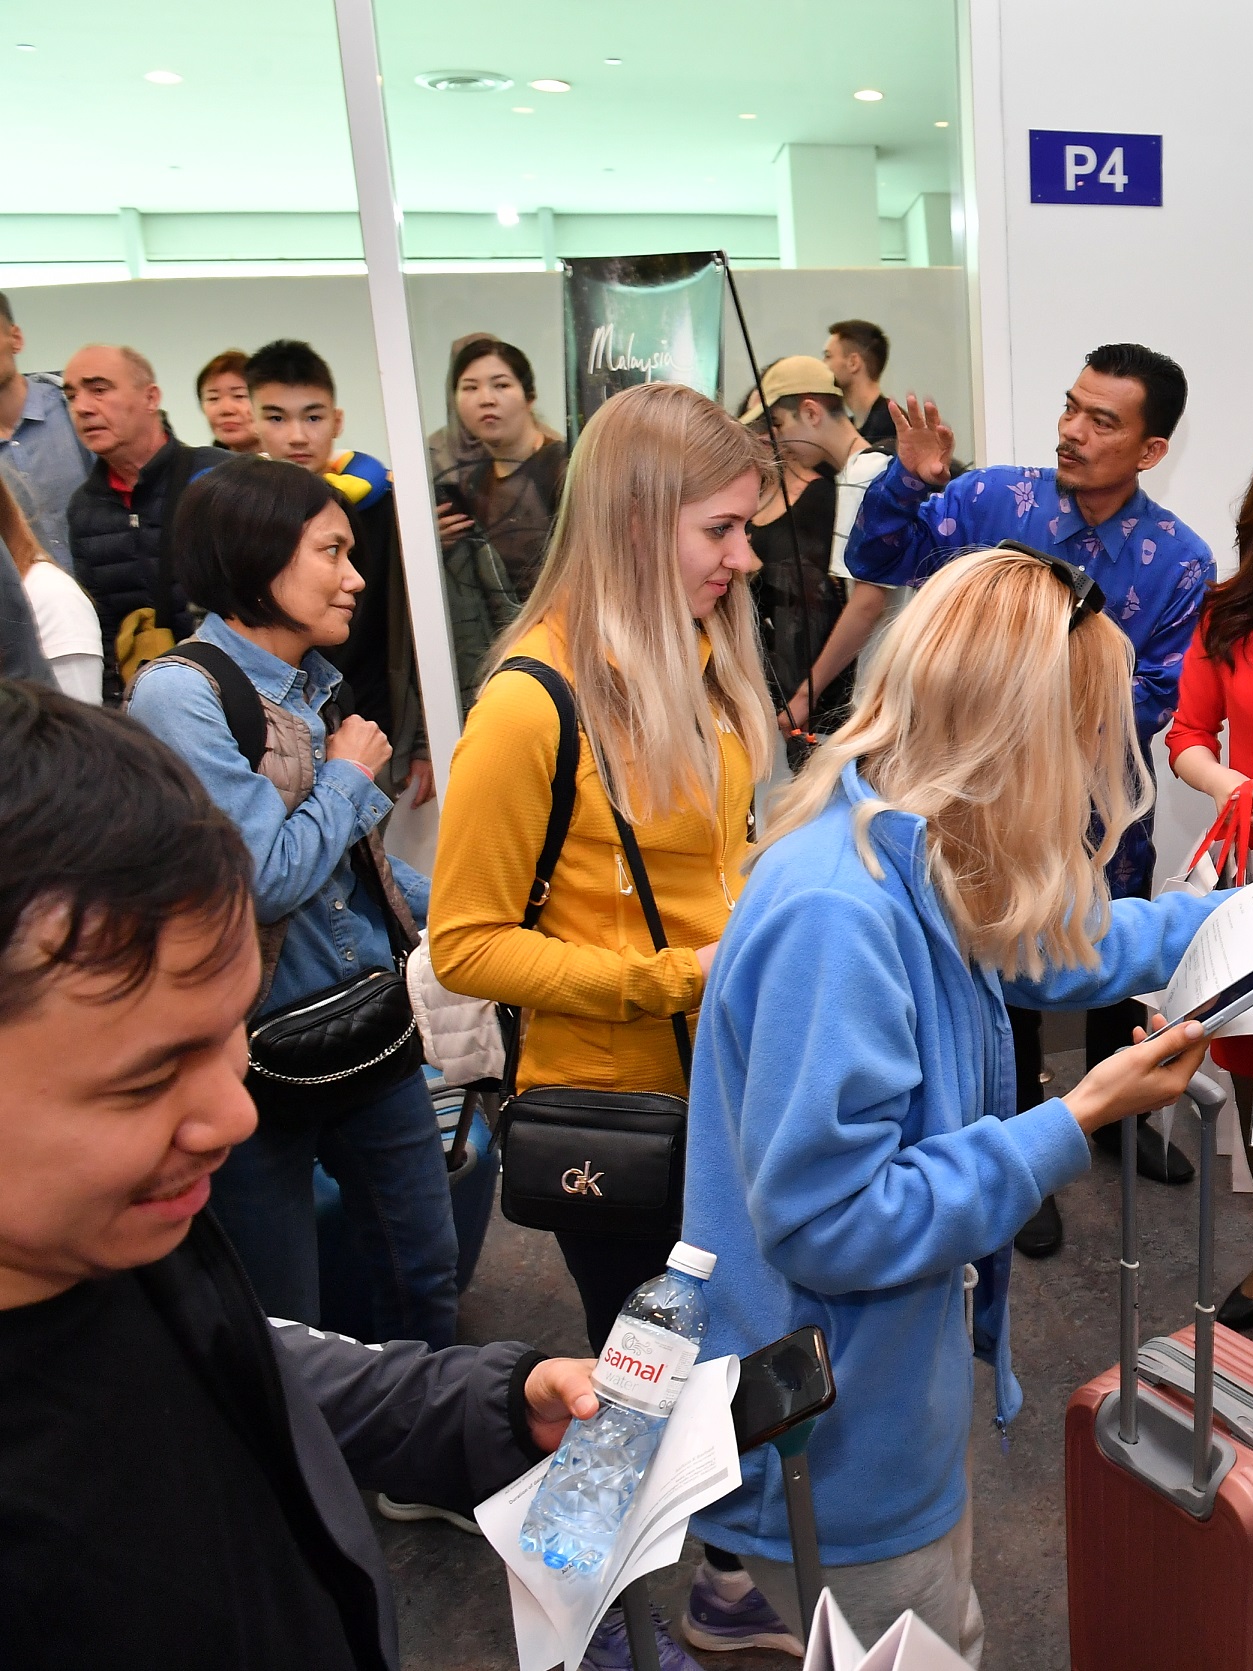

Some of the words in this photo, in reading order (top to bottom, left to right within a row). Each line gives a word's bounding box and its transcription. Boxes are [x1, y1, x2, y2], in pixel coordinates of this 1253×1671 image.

[1064, 144, 1129, 193] P4
[587, 322, 693, 384] Malaysia
[604, 1347, 665, 1384] samal
[604, 1371, 640, 1392] water
